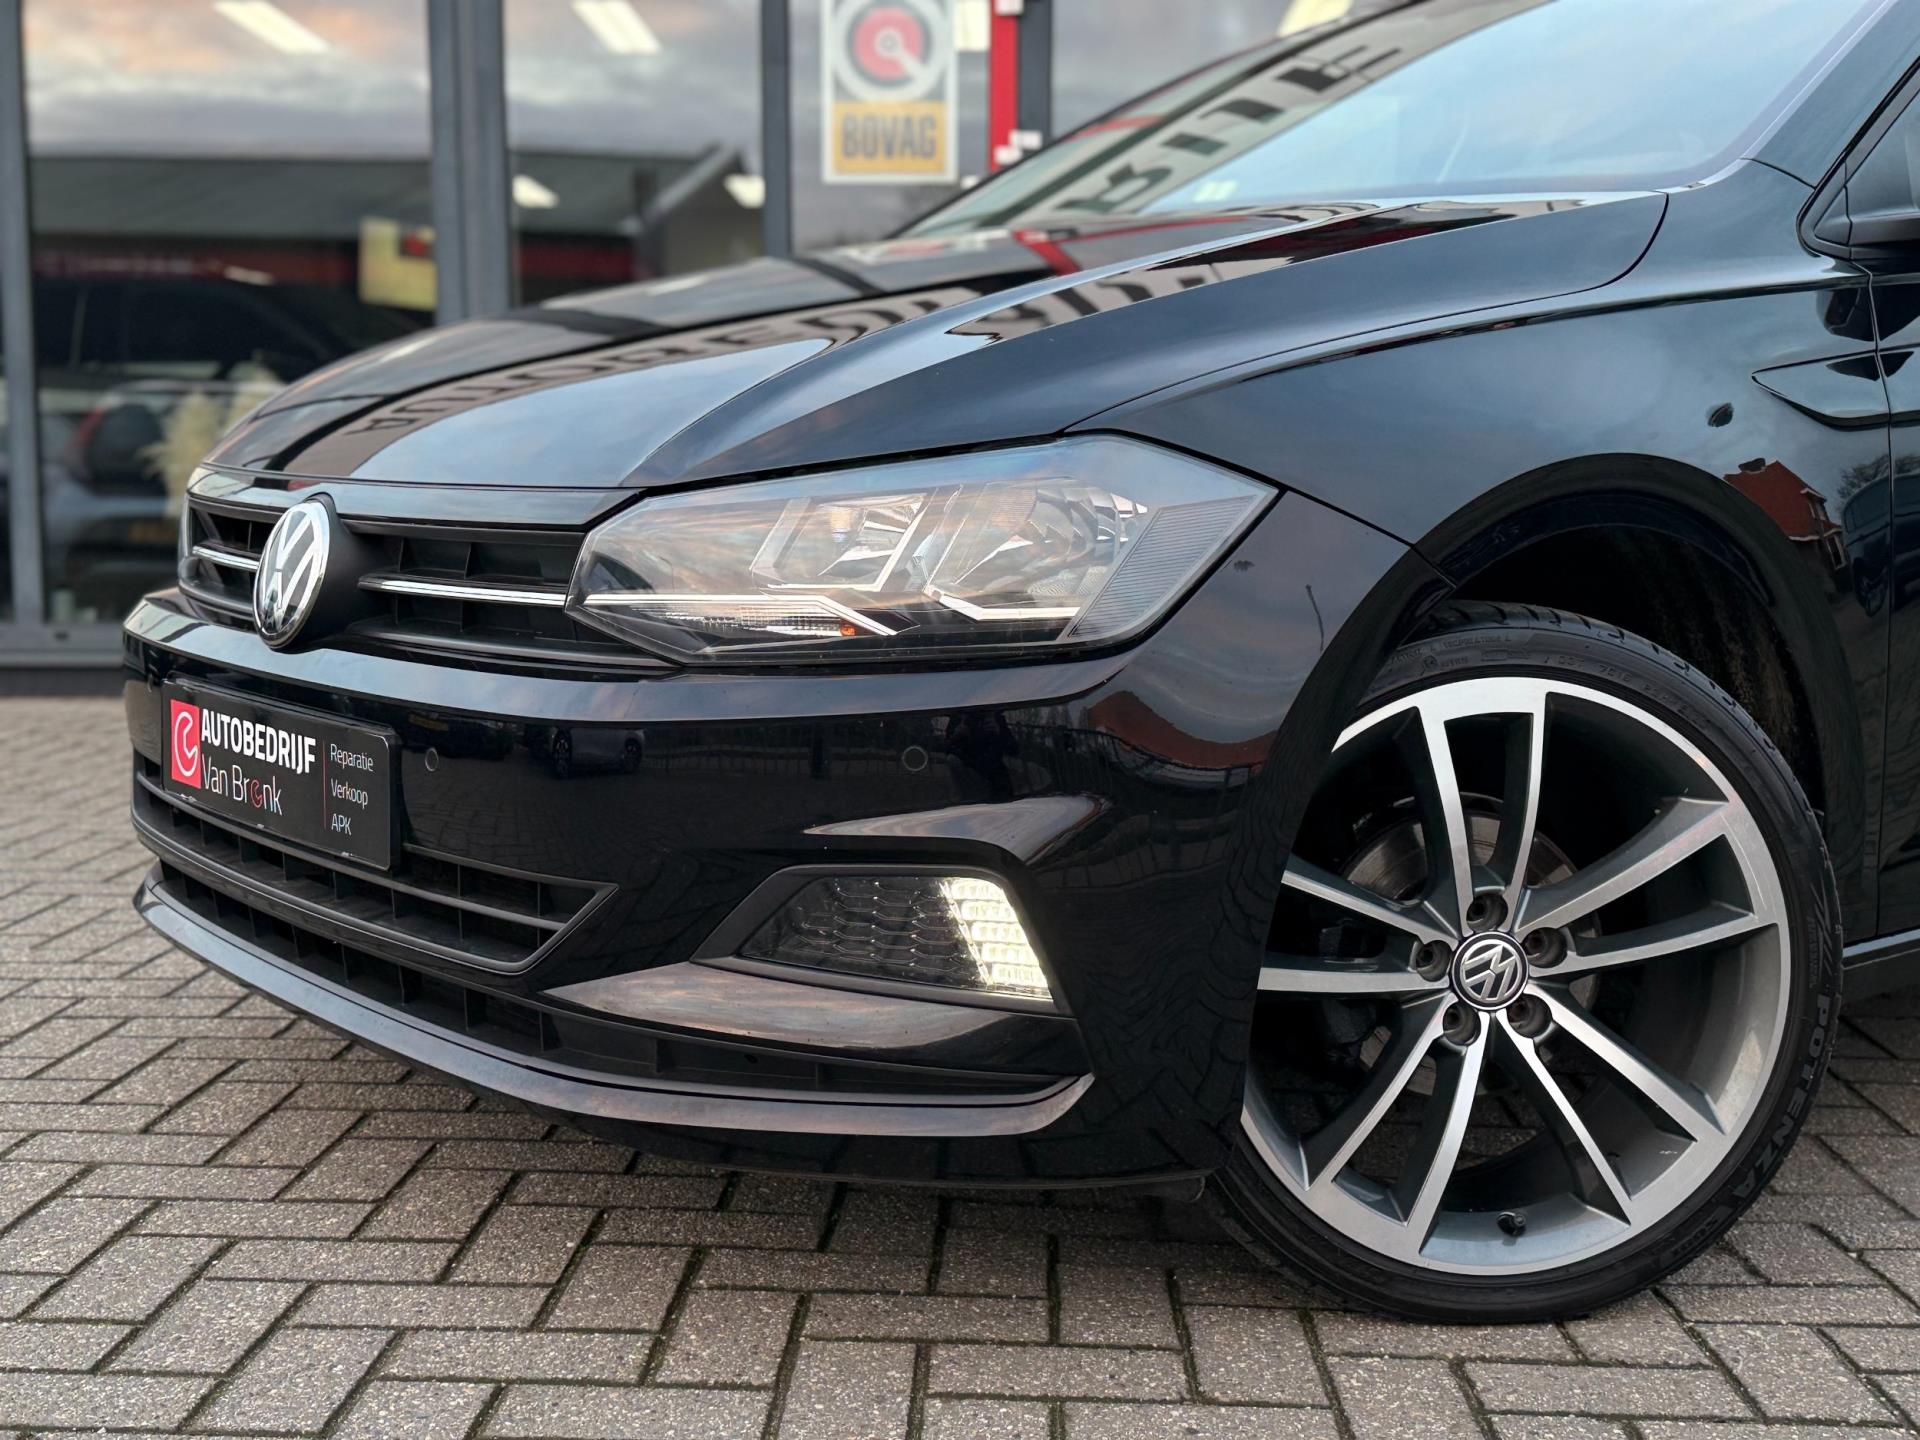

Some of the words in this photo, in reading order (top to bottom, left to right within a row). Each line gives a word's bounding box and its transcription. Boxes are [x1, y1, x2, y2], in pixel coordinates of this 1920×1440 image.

[842, 112, 938, 160] BOVAG
[201, 708, 317, 774] AUTOBEDRIJF
[330, 743, 374, 772] Reparatie
[202, 754, 229, 798] Van
[331, 779, 369, 810] Verkoop
[331, 813, 352, 836] APK
[1733, 994, 1831, 1198] POTENZA
